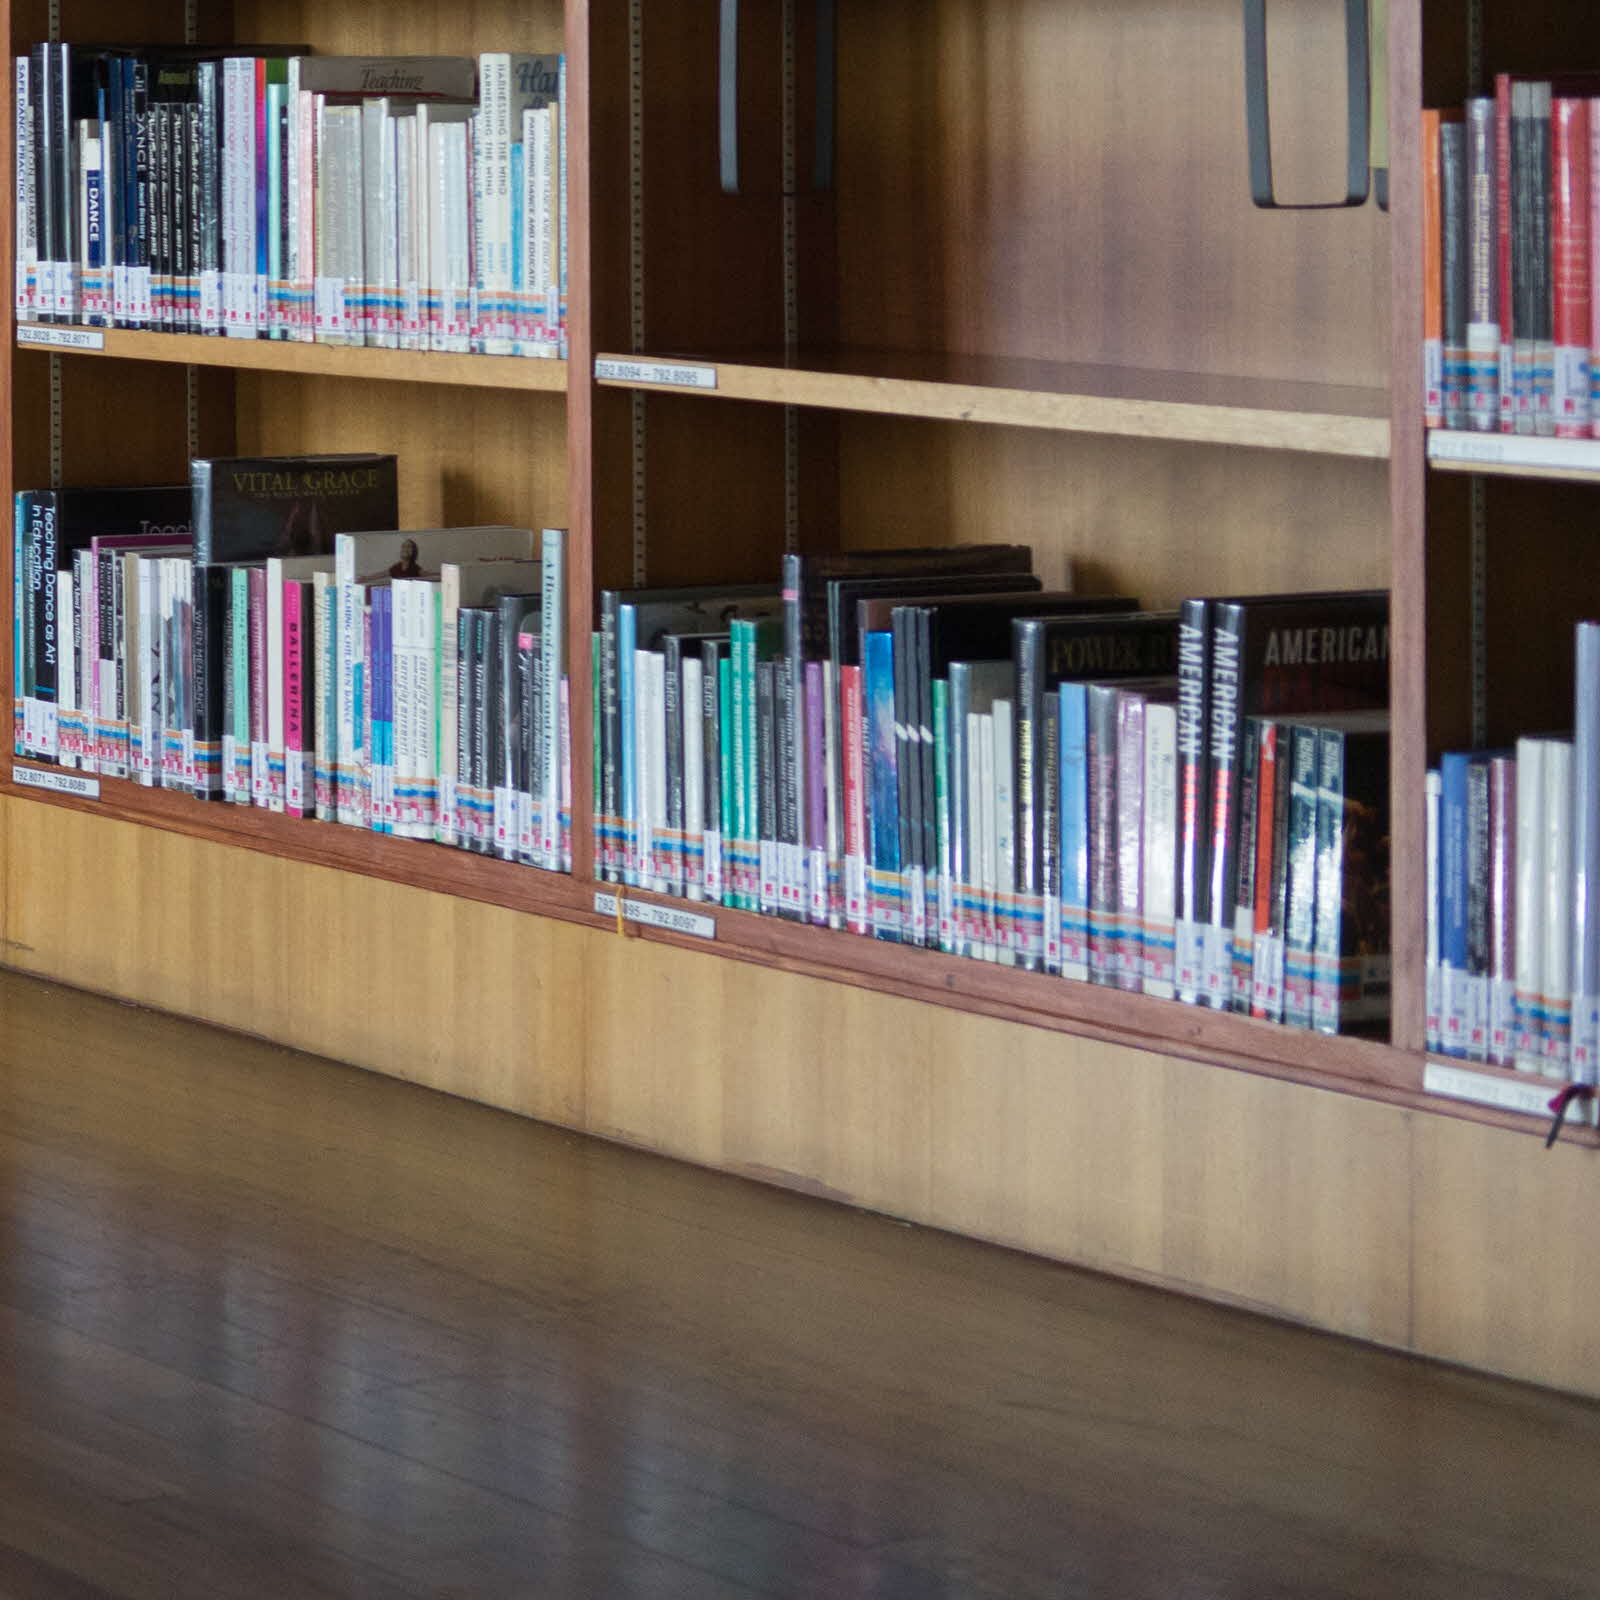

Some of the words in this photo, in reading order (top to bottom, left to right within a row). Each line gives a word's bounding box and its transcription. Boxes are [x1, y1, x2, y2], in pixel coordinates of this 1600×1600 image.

[18, 64, 26, 94] SAFE
[18, 98, 26, 139] DANCE
[484, 64, 493, 136] HARNESSING
[498, 64, 507, 136] HARNESSING
[484, 141, 493, 161] THE
[498, 141, 507, 161] THE
[528, 116, 536, 178] PARTNERING
[18, 145, 26, 202] PRACTICE
[90, 187, 99, 242] DANCE
[528, 180, 536, 215] DANCE
[528, 217, 536, 238] AND
[232, 471, 300, 493] VITAL
[302, 470, 379, 490] GRACE
[32, 504, 43, 518] in
[32, 520, 43, 591] Education
[44, 506, 56, 571] Teaching
[73, 559, 81, 585] Dance
[544, 560, 554, 568] A
[44, 574, 56, 620] Dance
[73, 586, 81, 611] About
[544, 575, 554, 629] History
[44, 624, 56, 641] as
[73, 612, 81, 648] Anything
[544, 632, 554, 648] of
[44, 644, 56, 664] Art
[785, 658, 796, 681] new
[290, 622, 298, 732] BALLERINA
[417, 656, 427, 706] converging
[458, 658, 467, 699] African
[475, 661, 484, 699] African
[665, 671, 676, 712] Butoh
[704, 675, 715, 717] Butoh
[1178, 624, 1202, 756] AMERICAN
[1211, 627, 1239, 759] AMERICAN
[344, 689, 352, 724] DANCE
[785, 684, 796, 741] directions
[398, 706, 407, 756] movements
[417, 707, 427, 758] movements
[458, 704, 467, 753] American
[475, 705, 484, 755] American
[544, 734, 554, 783] Dance
